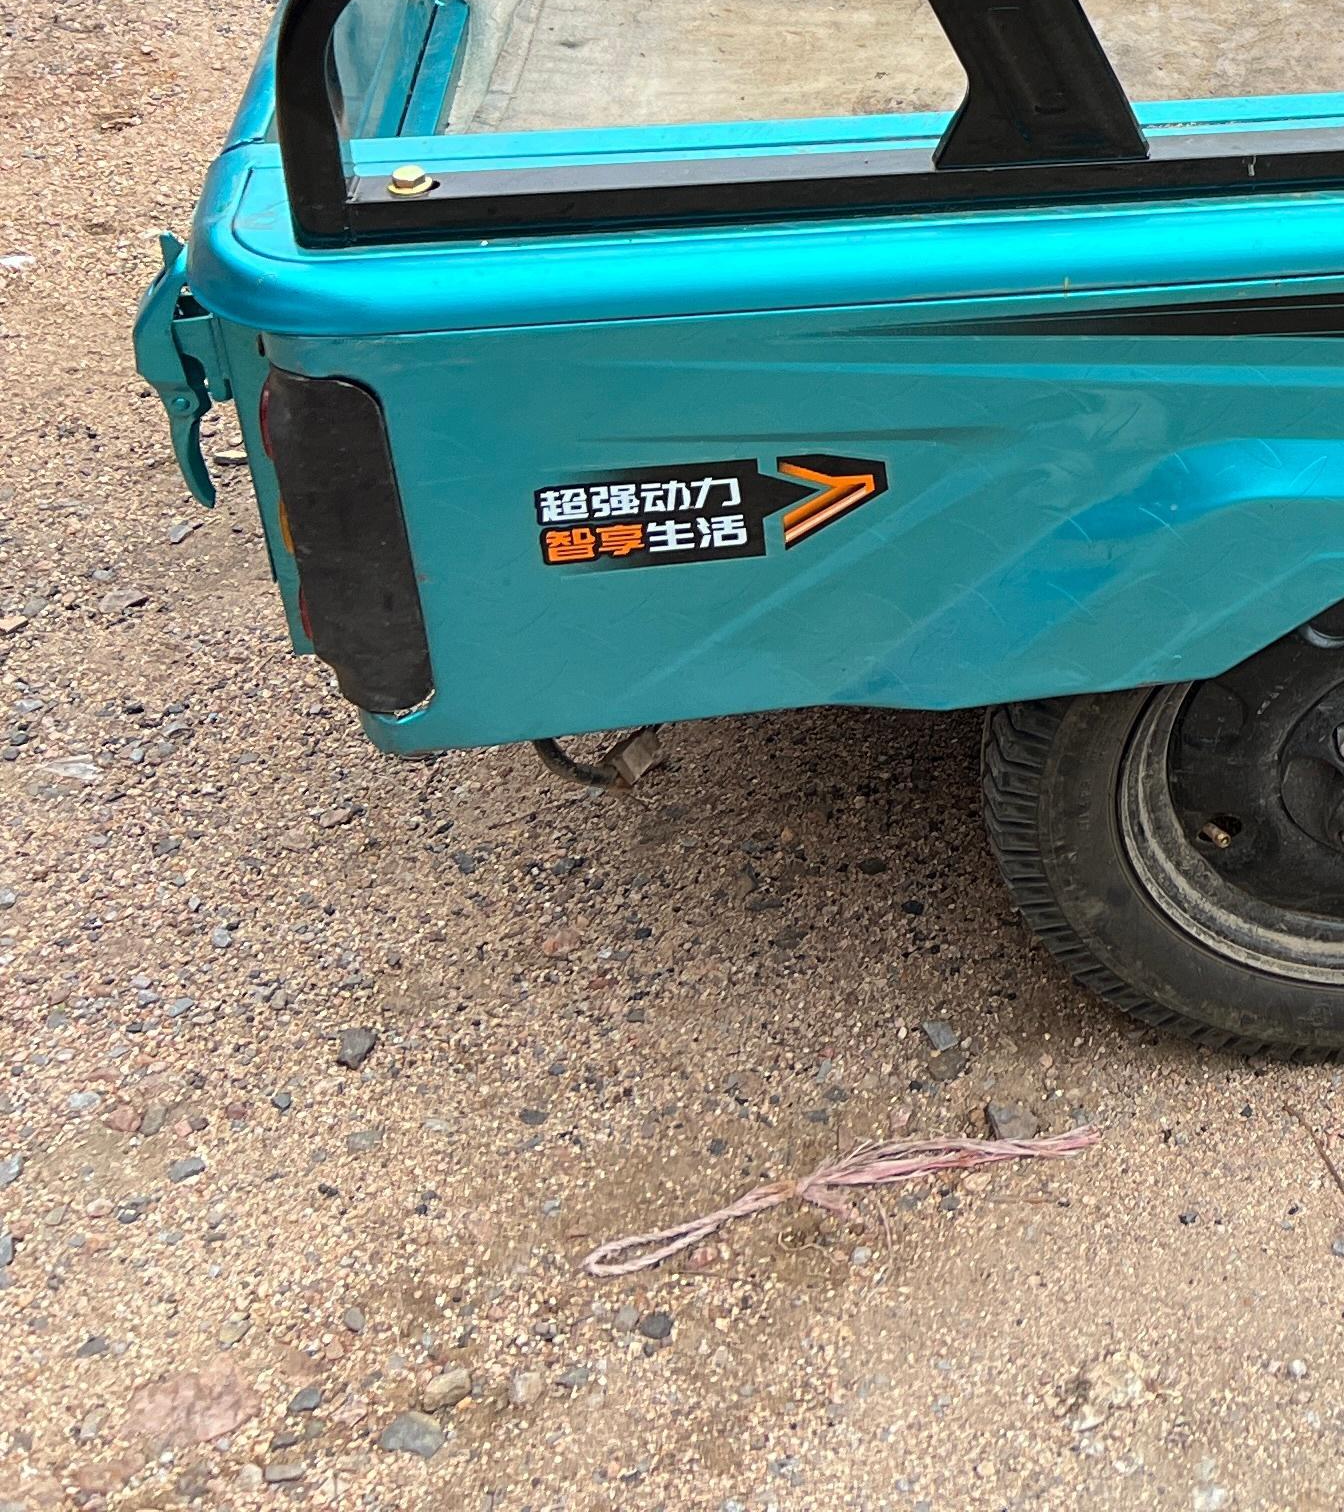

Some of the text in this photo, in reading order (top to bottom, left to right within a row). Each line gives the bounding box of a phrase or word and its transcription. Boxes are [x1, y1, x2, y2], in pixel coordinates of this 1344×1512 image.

[540, 477, 742, 523] 超强动力
[546, 513, 748, 563] 智享生活
